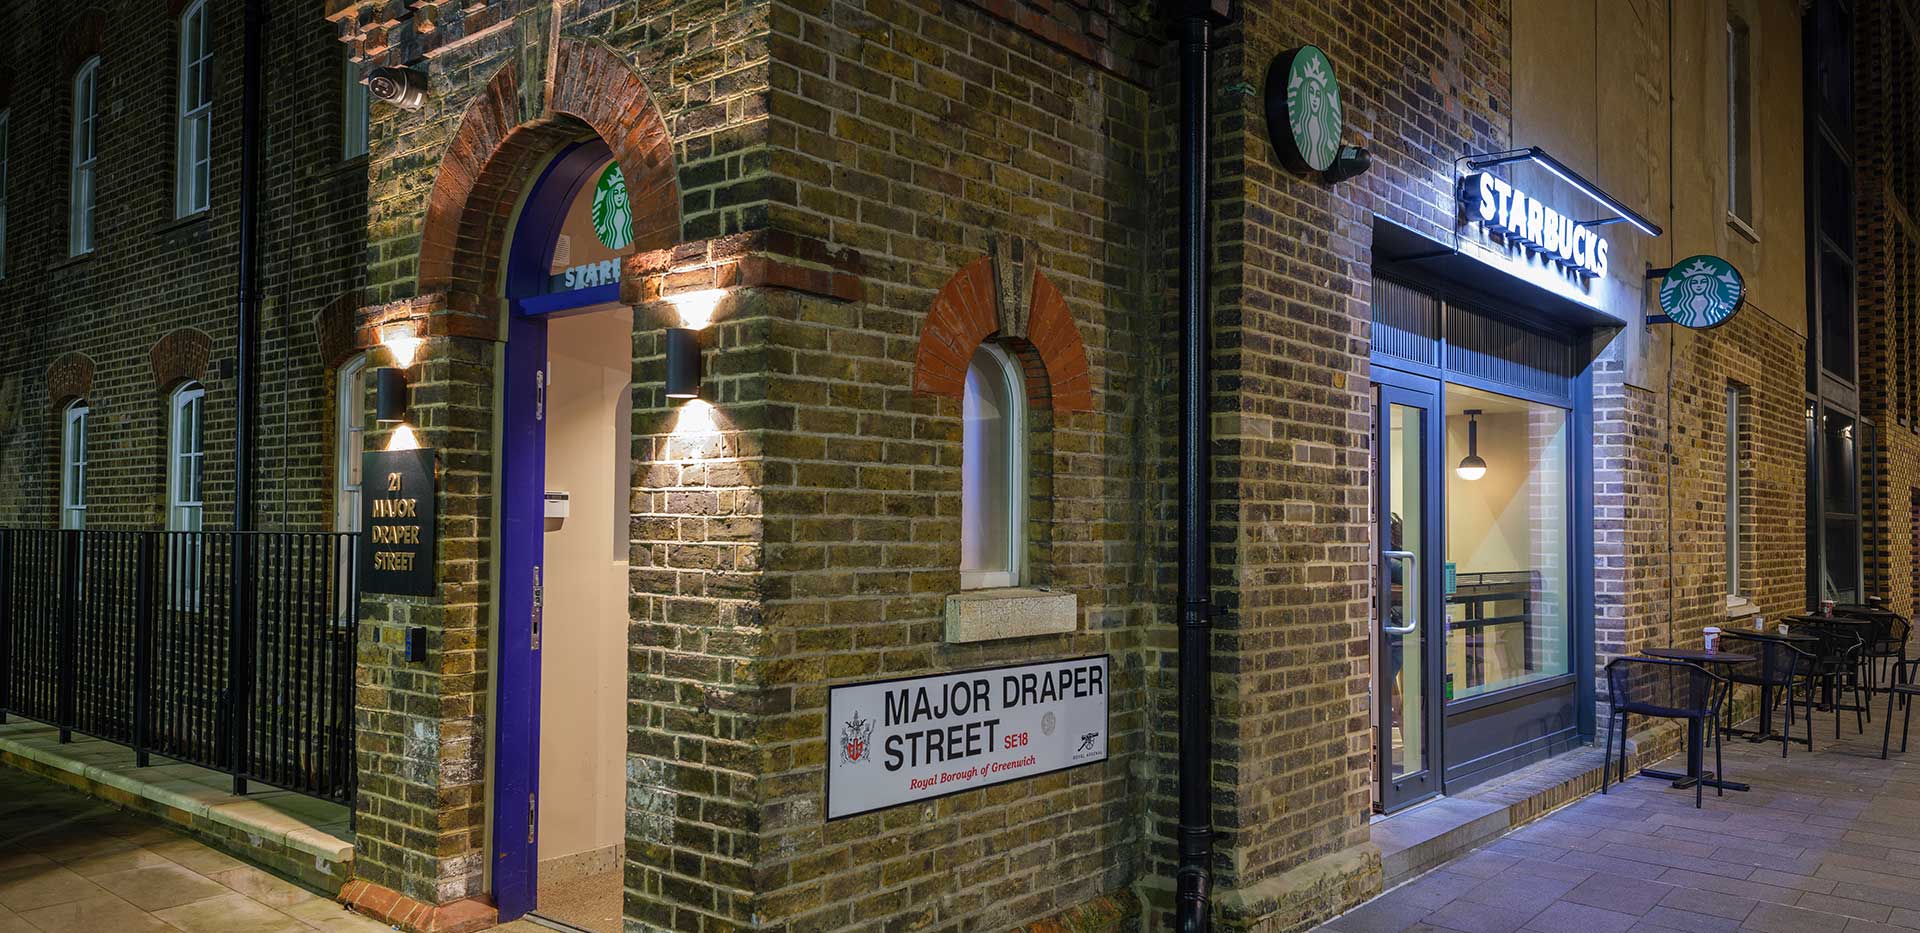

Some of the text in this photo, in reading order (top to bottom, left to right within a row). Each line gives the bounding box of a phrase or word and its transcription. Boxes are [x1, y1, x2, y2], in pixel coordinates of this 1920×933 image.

[1479, 171, 1608, 280] STARBUCKS
[388, 472, 402, 492] 21
[371, 498, 417, 518] MAJOR
[371, 525, 420, 545] DRAPER
[374, 551, 416, 572] STREET
[884, 665, 1103, 727] MAJOR DRAPER
[884, 719, 1029, 772] STREET SE18
[909, 755, 1036, 791] Royal Borough of Greenwich
